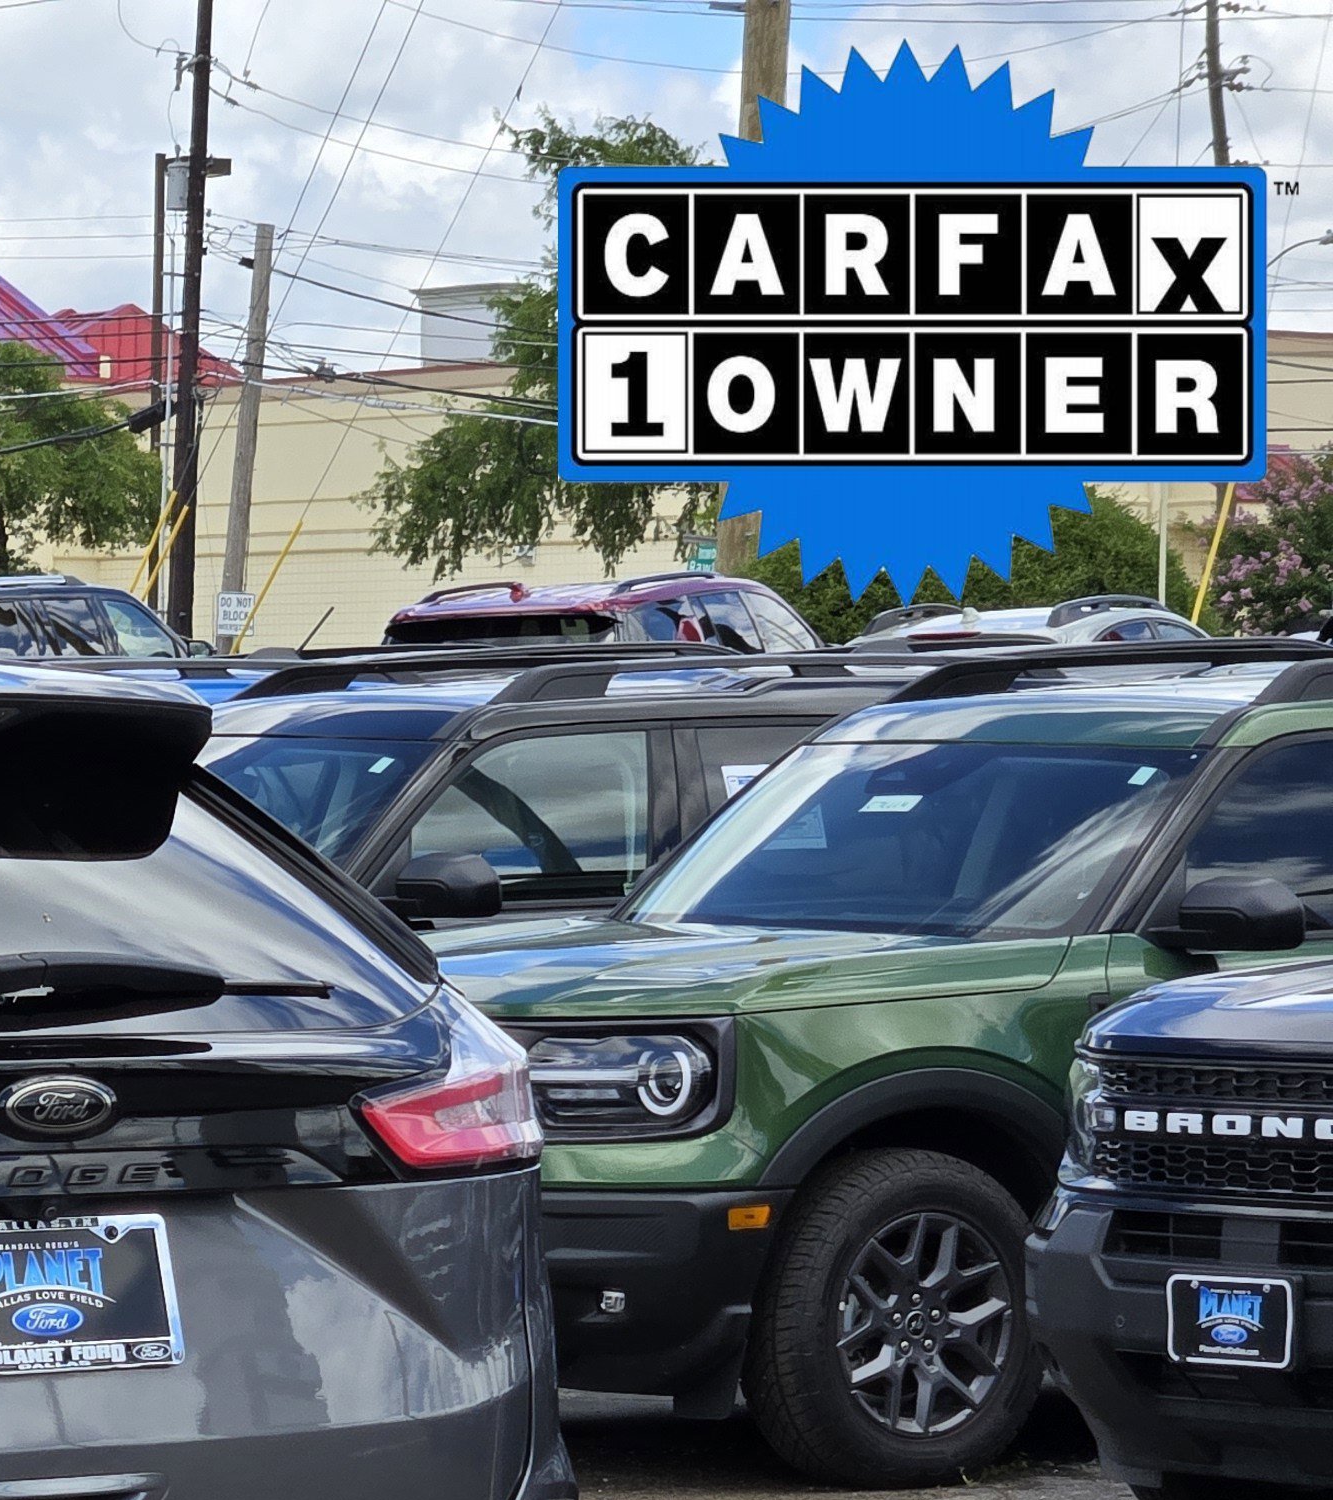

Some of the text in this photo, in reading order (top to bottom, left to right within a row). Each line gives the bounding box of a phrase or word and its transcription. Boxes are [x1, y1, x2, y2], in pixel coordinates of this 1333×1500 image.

[220, 597, 252, 608] DO NOT
[34, 1091, 89, 1121] Ford
[35, 1291, 66, 1301] LOVE
[69, 1292, 104, 1308] FIELD
[1198, 1285, 1263, 1326] PLANET
[25, 1307, 69, 1331] Ford
[70, 1343, 127, 1363] FORD
